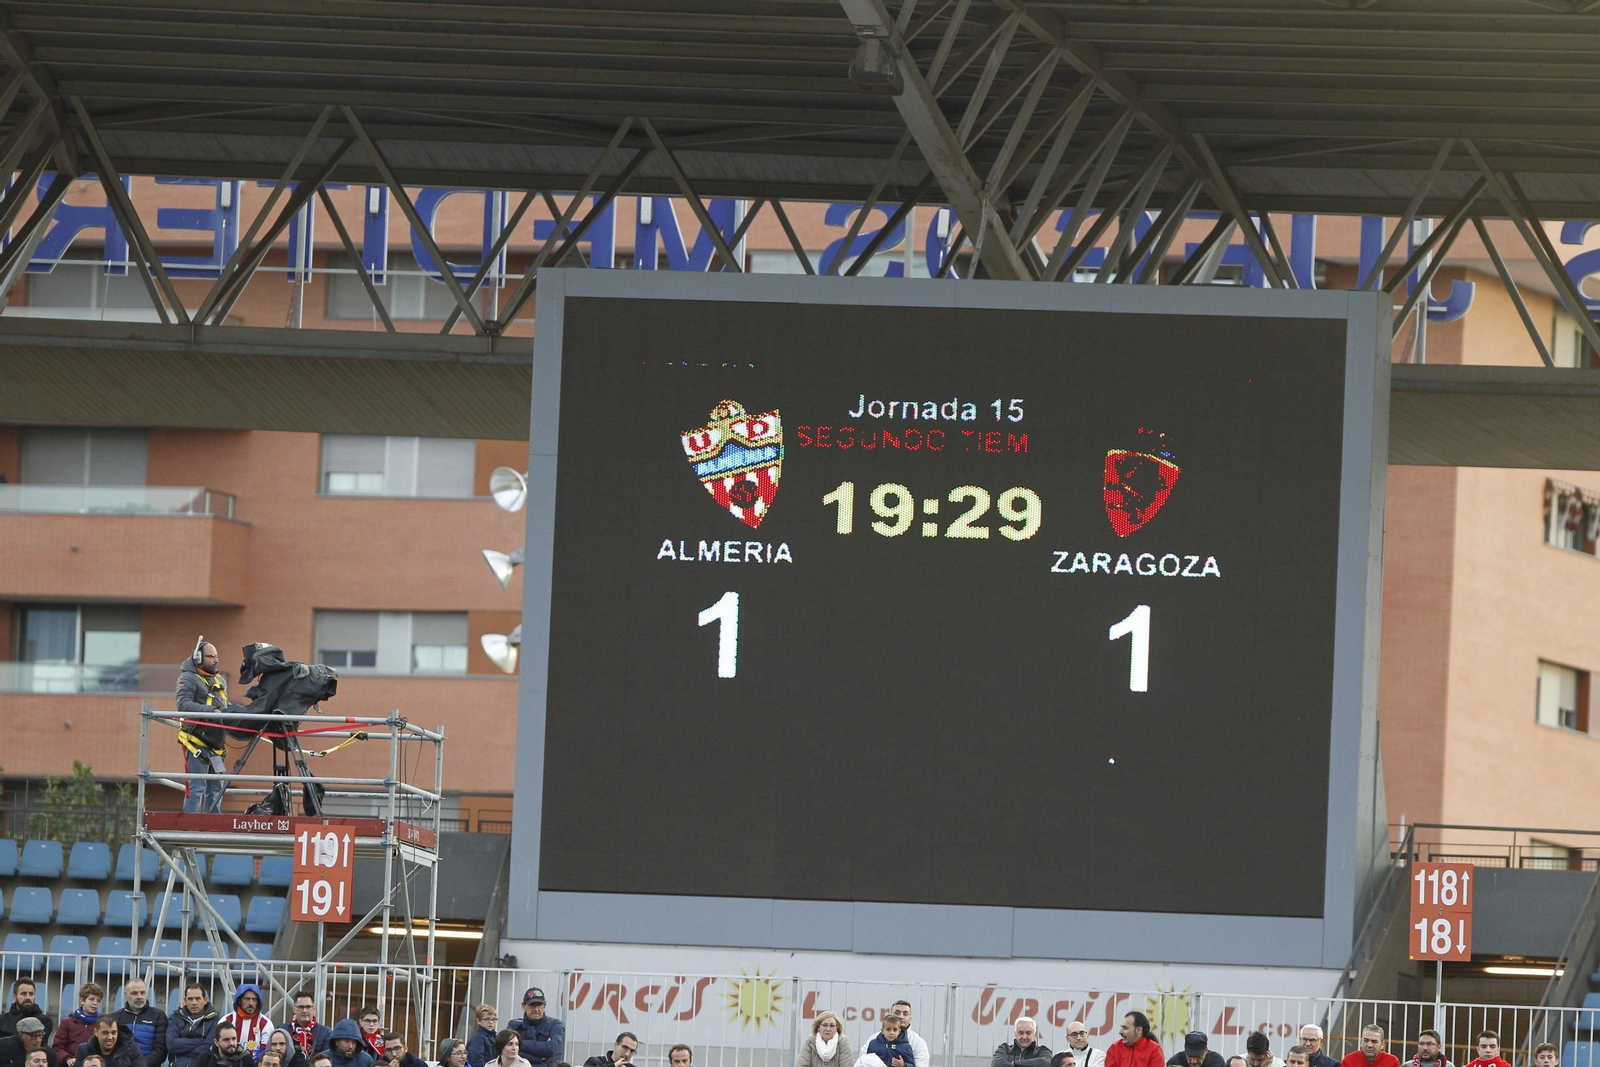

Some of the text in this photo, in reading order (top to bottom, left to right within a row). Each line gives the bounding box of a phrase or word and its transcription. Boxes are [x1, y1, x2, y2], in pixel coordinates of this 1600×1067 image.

[848, 394, 1024, 423] Jornada 15
[821, 481, 1042, 542] 19:29
[656, 538, 793, 564] ALMERIA
[1050, 550, 1221, 578] ZARAGOZA
[697, 591, 740, 679] 1
[1108, 604, 1151, 693] 1
[233, 818, 274, 831] Layher
[298, 831, 339, 868] 119
[296, 879, 333, 916] 19
[1414, 869, 1458, 906] 118
[1414, 918, 1452, 955] 18
